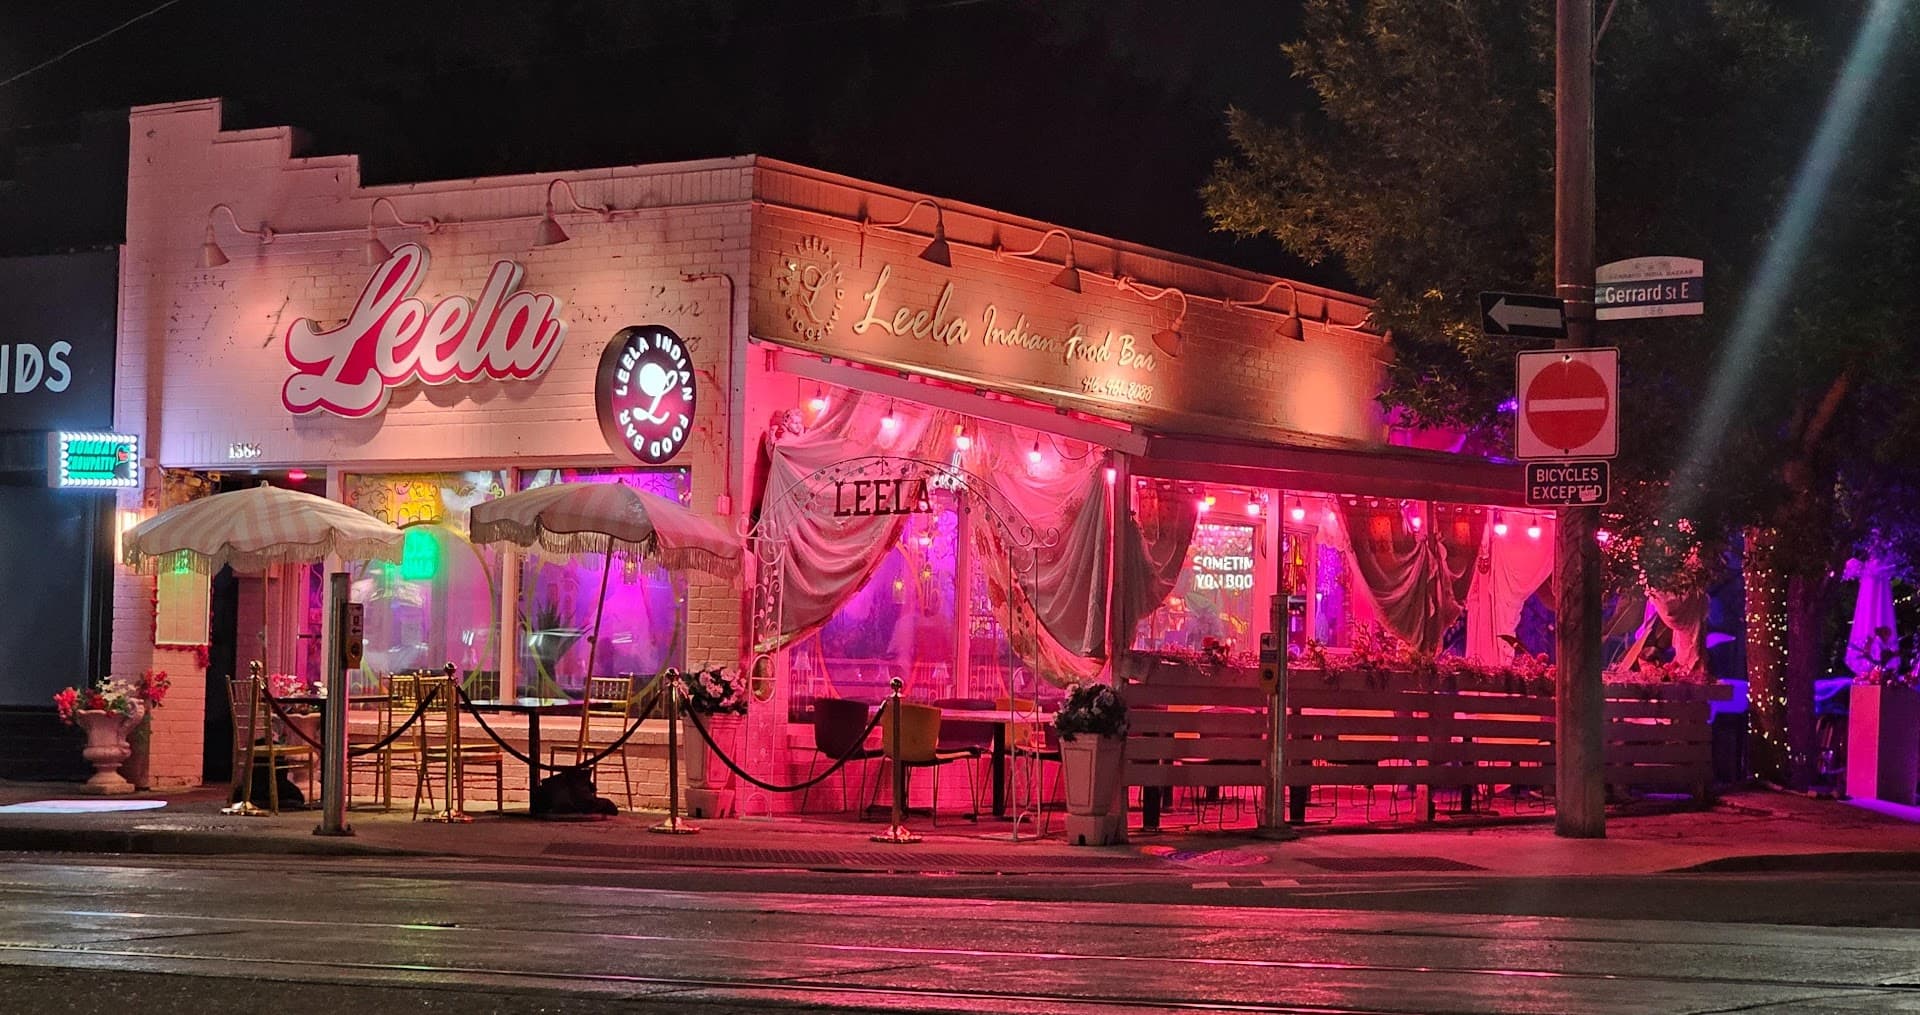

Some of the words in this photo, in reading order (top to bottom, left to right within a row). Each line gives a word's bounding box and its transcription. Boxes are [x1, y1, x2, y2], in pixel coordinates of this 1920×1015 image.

[1605, 284, 1662, 304] Gerrard
[1665, 286, 1677, 300] St
[1681, 281, 1690, 299] E
[282, 243, 567, 418] Leela
[853, 264, 970, 346] Leela
[983, 304, 1055, 351] Indian
[1065, 323, 1113, 364] Food
[1118, 334, 1156, 372] Bar
[616, 336, 650, 396] LEELA
[655, 333, 693, 401] INDIAN
[619, 409, 645, 451] BAR
[650, 414, 689, 457] FOOD
[1536, 467, 1599, 482] BICYCLES
[834, 478, 933, 516] LEELA
